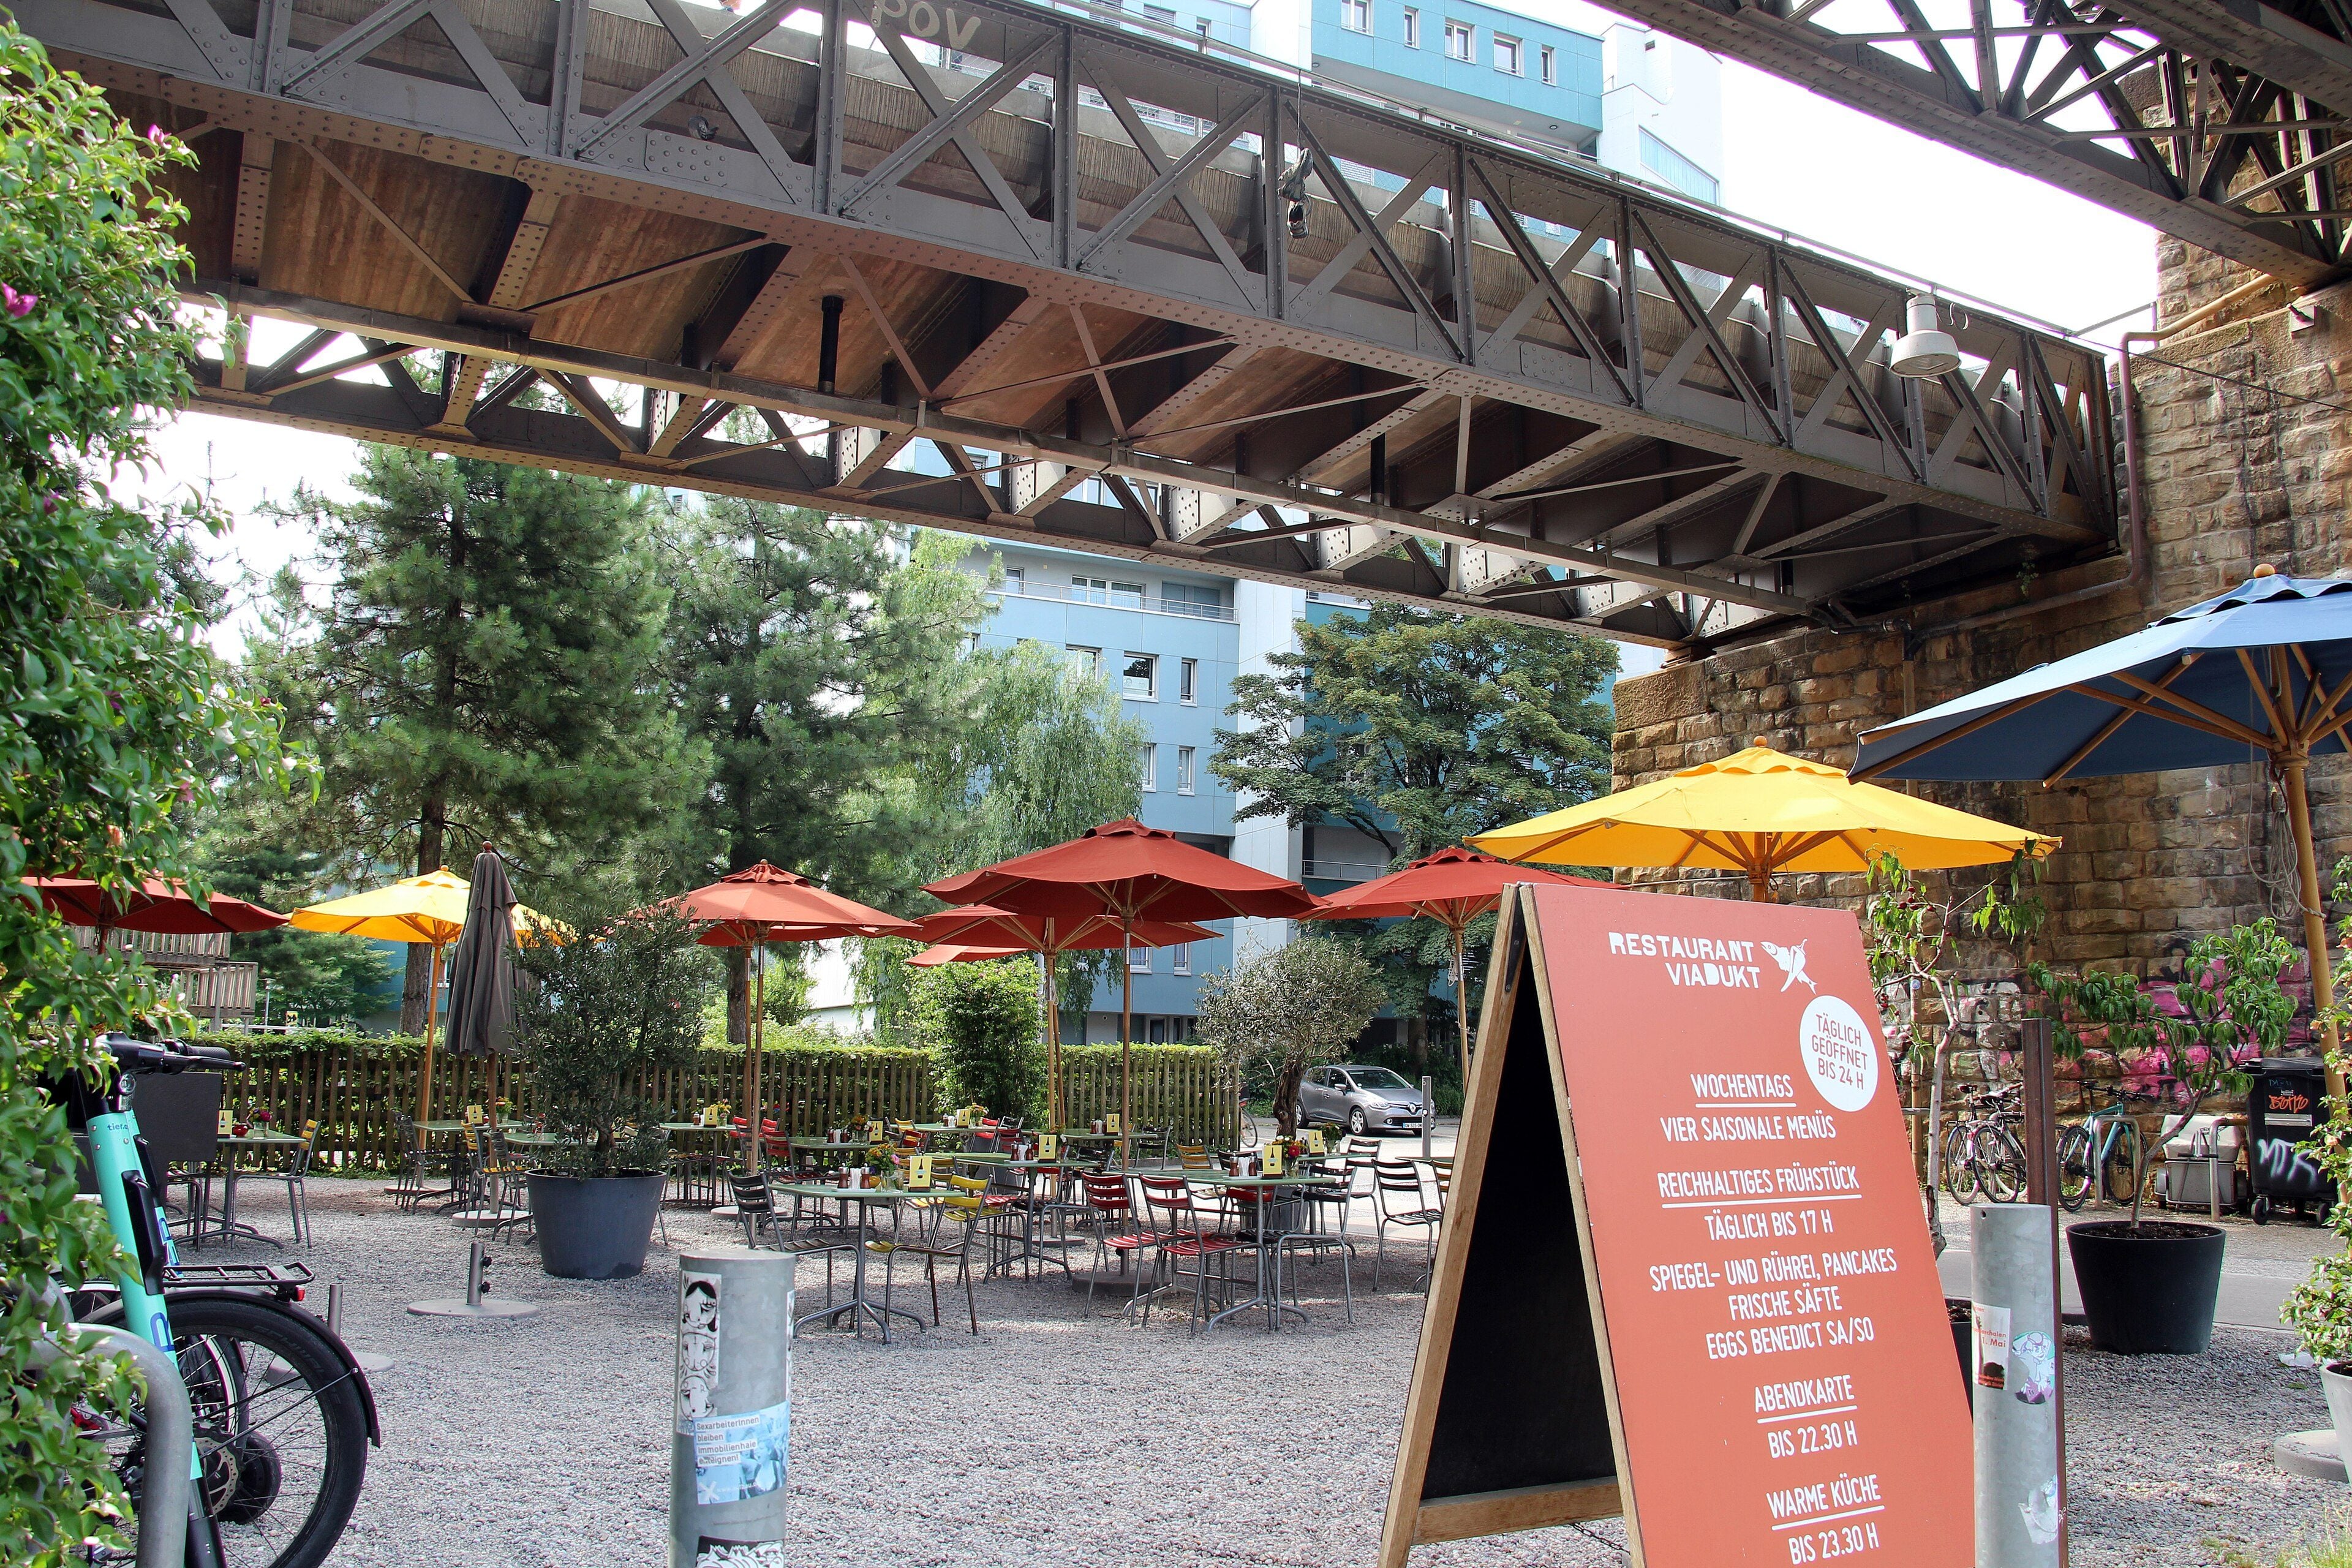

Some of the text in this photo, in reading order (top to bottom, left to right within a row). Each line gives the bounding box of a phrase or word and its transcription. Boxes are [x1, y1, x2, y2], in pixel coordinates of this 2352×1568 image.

[1608, 932, 1754, 962] RESTAURANT
[1665, 962, 1760, 989] VIADUKT
[1815, 1012, 1861, 1047] TÄGLICH
[1812, 1035, 1868, 1070] GEÖFFNET
[1690, 1073, 1793, 1098] WOCHENTAGS
[1818, 1057, 1863, 1090] BIS 24 H
[1660, 1109, 1836, 1142] VIER SAISONALE MENÜS
[1657, 1160, 1860, 1198] REICHHALTIGES FRÜHSTÜCK
[1704, 1208, 1833, 1241] TÄGLICH BIS 17 H
[1649, 1248, 1898, 1292] SPIEGEL- UND RÜHREI, PANCAKES
[1728, 1283, 1842, 1321] FRISCHE SÄFTE
[1706, 1316, 1874, 1360] EGGS BENEDICT SA/SO
[1990, 1338, 2006, 1348] Mai
[1755, 1374, 1855, 1413] ABENDKARTE
[696, 1417, 760, 1430] SexarbeiterInnen
[697, 1434, 724, 1442] bleiben
[1767, 1420, 1858, 1458] BIS 22.30 H
[698, 1441, 756, 1454] Immobilienhaie
[1766, 1472, 1882, 1519] WARME KÜCHE
[1788, 1521, 1879, 1565] BIS 23.30 H
